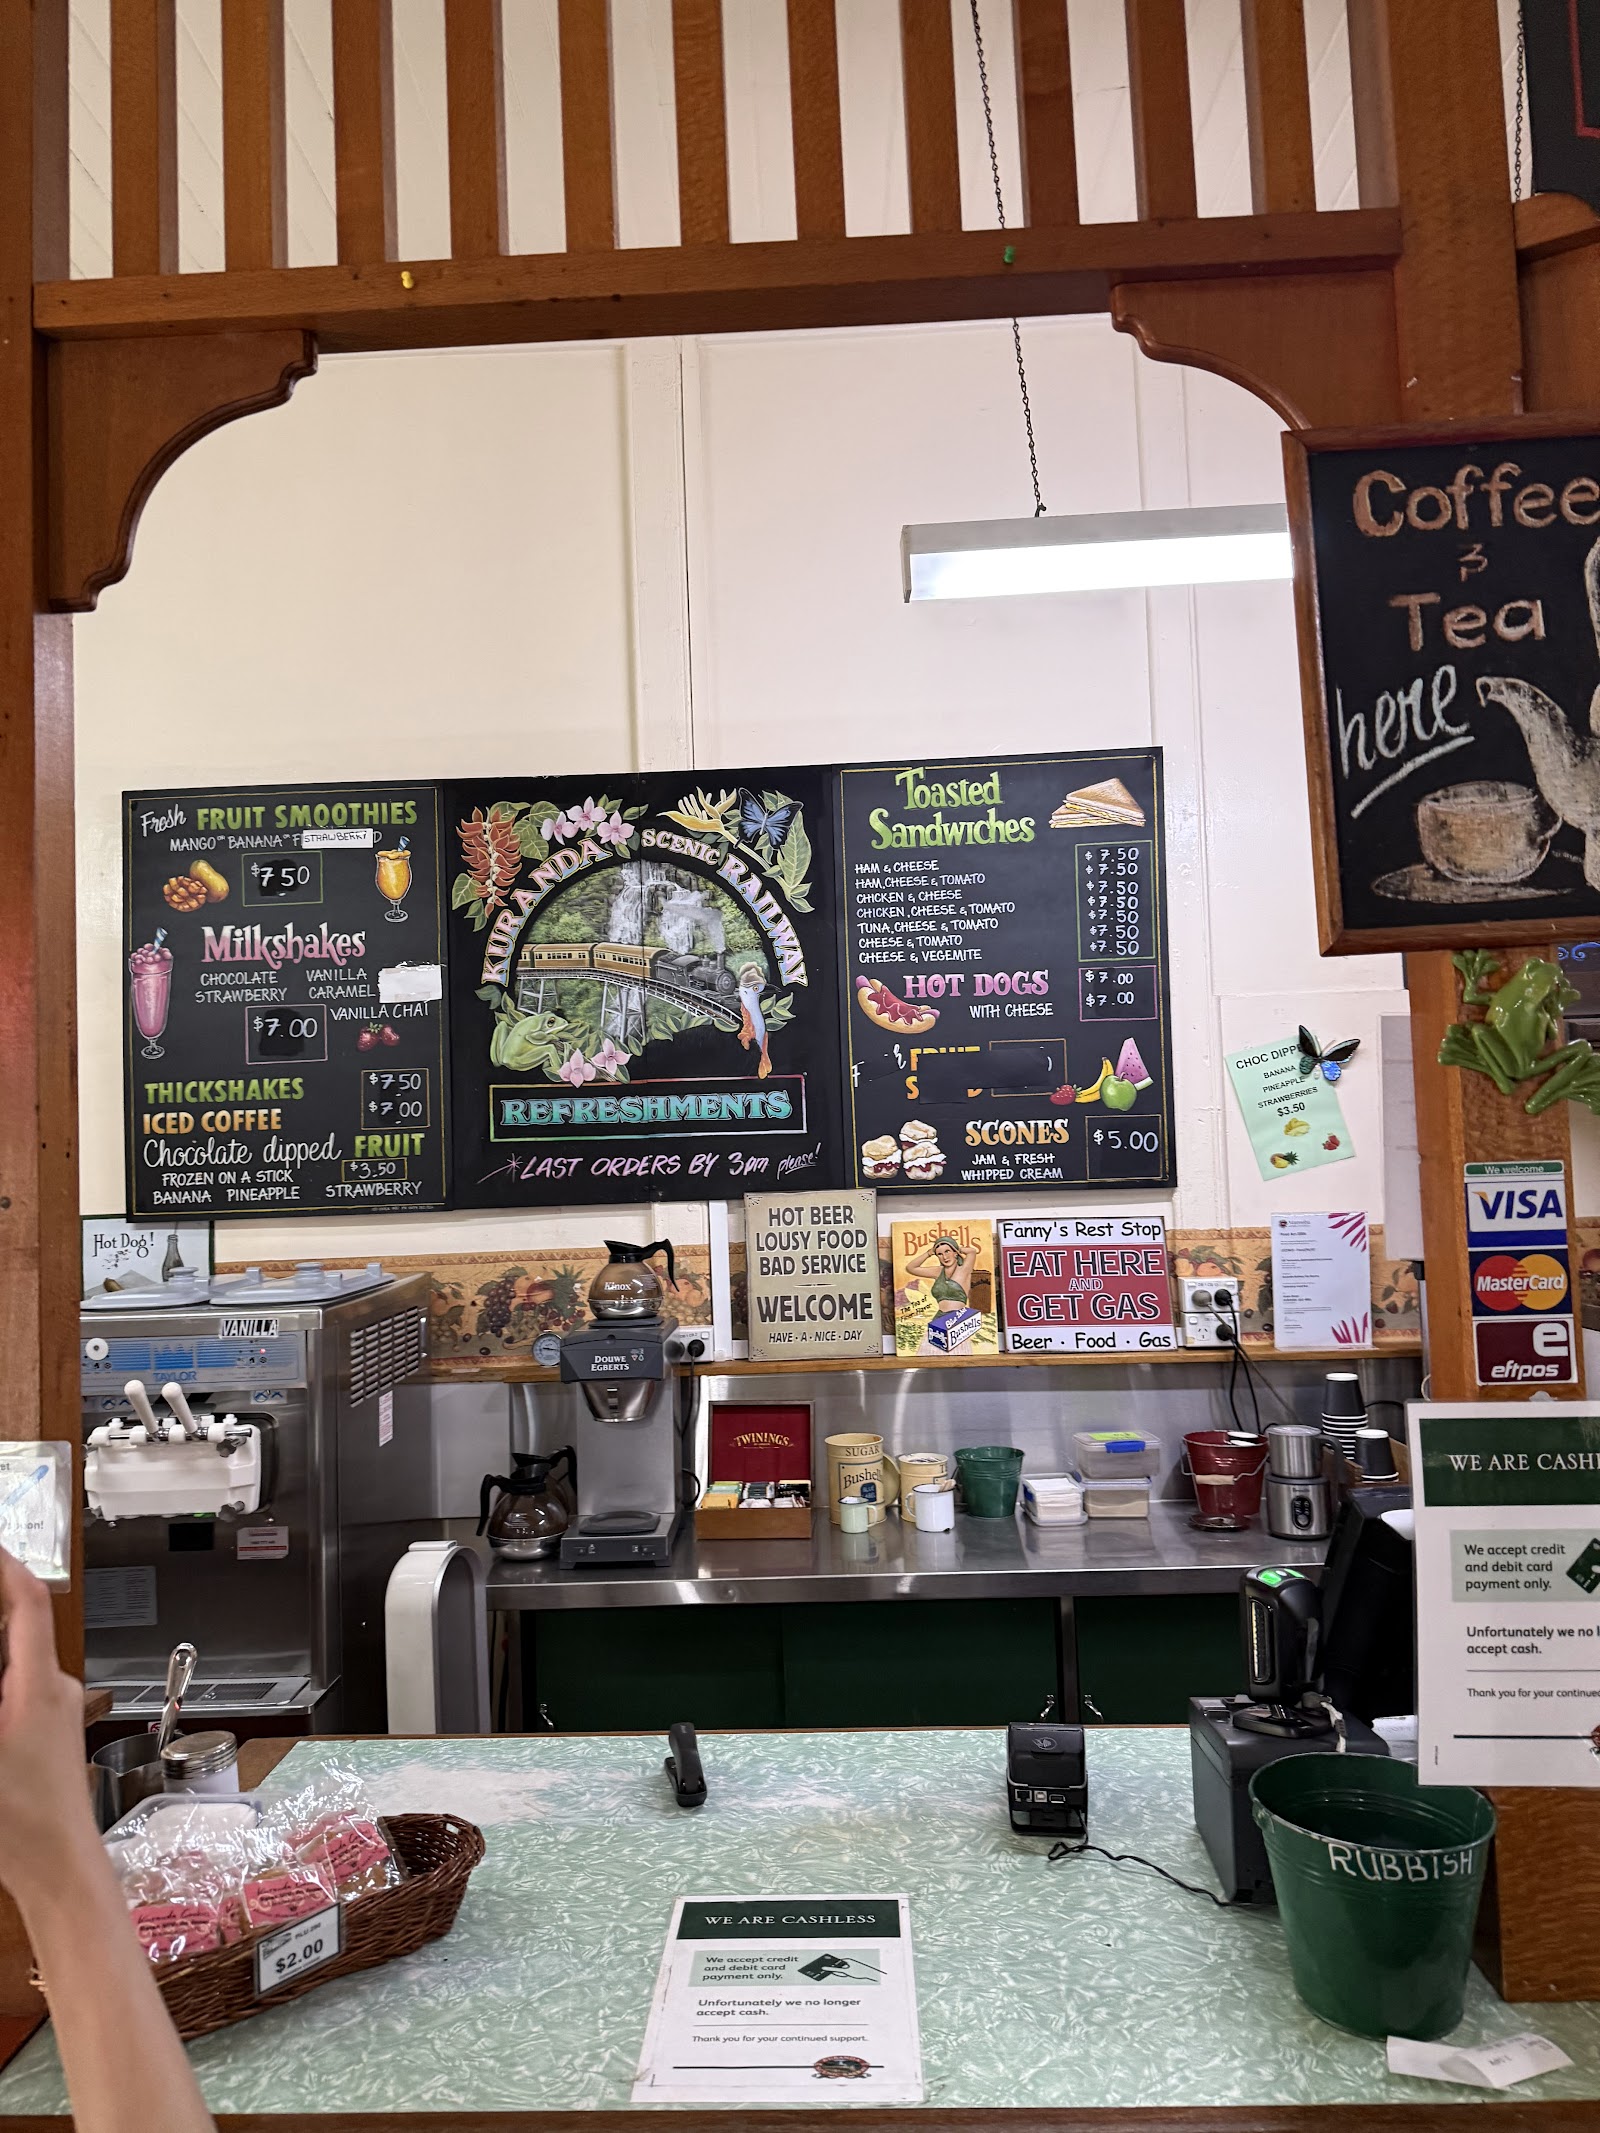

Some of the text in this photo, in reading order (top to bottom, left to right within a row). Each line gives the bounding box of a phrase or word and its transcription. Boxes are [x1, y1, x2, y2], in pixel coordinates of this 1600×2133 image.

[1353, 461, 1600, 538] Coffee
[1389, 592, 1547, 652] Tea
[1336, 664, 1471, 779] here
[895, 767, 1003, 810] Toasted
[141, 801, 417, 836] Fresh FRUIT SMOOTHIES
[869, 808, 1035, 849] Sandwiches
[170, 837, 216, 852] MANGO
[228, 835, 282, 850] BANANA
[855, 860, 939, 874] HAM CHEESE
[940, 873, 985, 885] TOMATO
[857, 890, 962, 904] CHICKEN CHEESE
[482, 828, 808, 987] KURANDA SCENIC RAILWAY
[968, 902, 1015, 914] TOMATO
[950, 918, 998, 930] TOMATO
[201, 922, 366, 970] Milkshakes
[859, 935, 962, 948] CHEESE TOMATO
[859, 949, 982, 963] CHEESE VEGEMITE
[200, 969, 367, 986] CHOCOLATE VANILLA
[903, 970, 1049, 999] HOT DOGS
[195, 985, 375, 1003] STRAWBERRY CARAMEL
[330, 1001, 429, 1021] VANILLA CHAI
[970, 1003, 1053, 1018] WITH CHEESE
[1236, 1054, 1268, 1069] CHOC
[1264, 1065, 1296, 1078] BANANA
[144, 1078, 304, 1104] THICKSHAKES
[1263, 1076, 1305, 1093] PINEAPPLE
[1258, 1087, 1318, 1108] STRAWBERRIES
[501, 1090, 792, 1125] REFRESHMENTS
[1277, 1102, 1305, 1116] $3.50
[143, 1109, 282, 1135] ICED COFFEE
[965, 1119, 1158, 1153] SCONES $5.00
[143, 1133, 425, 1169] Chocolate dipped FRUIT
[971, 1154, 1055, 1166] JAM FRESH
[520, 1156, 583, 1179] LAST
[591, 1154, 681, 1177] ORDERS
[688, 1153, 718, 1177] BY
[729, 1152, 768, 1176] 3pm
[961, 1168, 1063, 1181] WHIPPED CREAM
[1484, 1165, 1544, 1174] We welcome
[162, 1169, 293, 1187] FROZEN ON A STICK
[153, 1181, 422, 1204] BANANA PINEAPPLE STRAWBERRY
[1472, 1190, 1563, 1220] VISA
[768, 1206, 854, 1226] HOT BEER
[756, 1230, 867, 1251] LOUSY FOOD
[903, 1222, 982, 1256] Bushells
[1003, 1222, 1161, 1242] Fanny's Rest Stop
[92, 1232, 154, 1258] Hot Dog!
[760, 1254, 866, 1276] BAD SERVICE
[1007, 1249, 1164, 1278] EAT HERE
[604, 1282, 631, 1290] Kinox
[1069, 1278, 1103, 1291] AND
[1477, 1274, 1564, 1292] MasterCard
[757, 1293, 873, 1322] WELCOME
[1017, 1293, 1160, 1321] GET GAS
[222, 1319, 279, 1337] VANILLA
[950, 1319, 981, 1346] Bushells
[1012, 1331, 1171, 1349] Beer Food Gas
[153, 1371, 197, 1382] TAYLOR
[1491, 1360, 1559, 1380] eftpos
[734, 1432, 790, 1447] TWININGS
[846, 1446, 880, 1456] SUGAR
[1448, 1454, 1530, 1471] WE ARE
[1464, 1544, 1566, 1557] We accept credit
[1465, 1562, 1553, 1572] and debit card
[1465, 1578, 1552, 1592] payment only.
[1467, 1626, 1593, 1639] Unfortunately we no
[1467, 1643, 1542, 1656] accept cash.
[1467, 1688, 1554, 1699] Thank you for your
[1328, 1843, 1472, 1882] RUBBISH
[705, 1915, 876, 1924] WE ARE CASHLESS
[276, 1939, 323, 1973] $2.00
[699, 1999, 782, 2007] Unfortunately
[824, 1999, 861, 2007] longer
